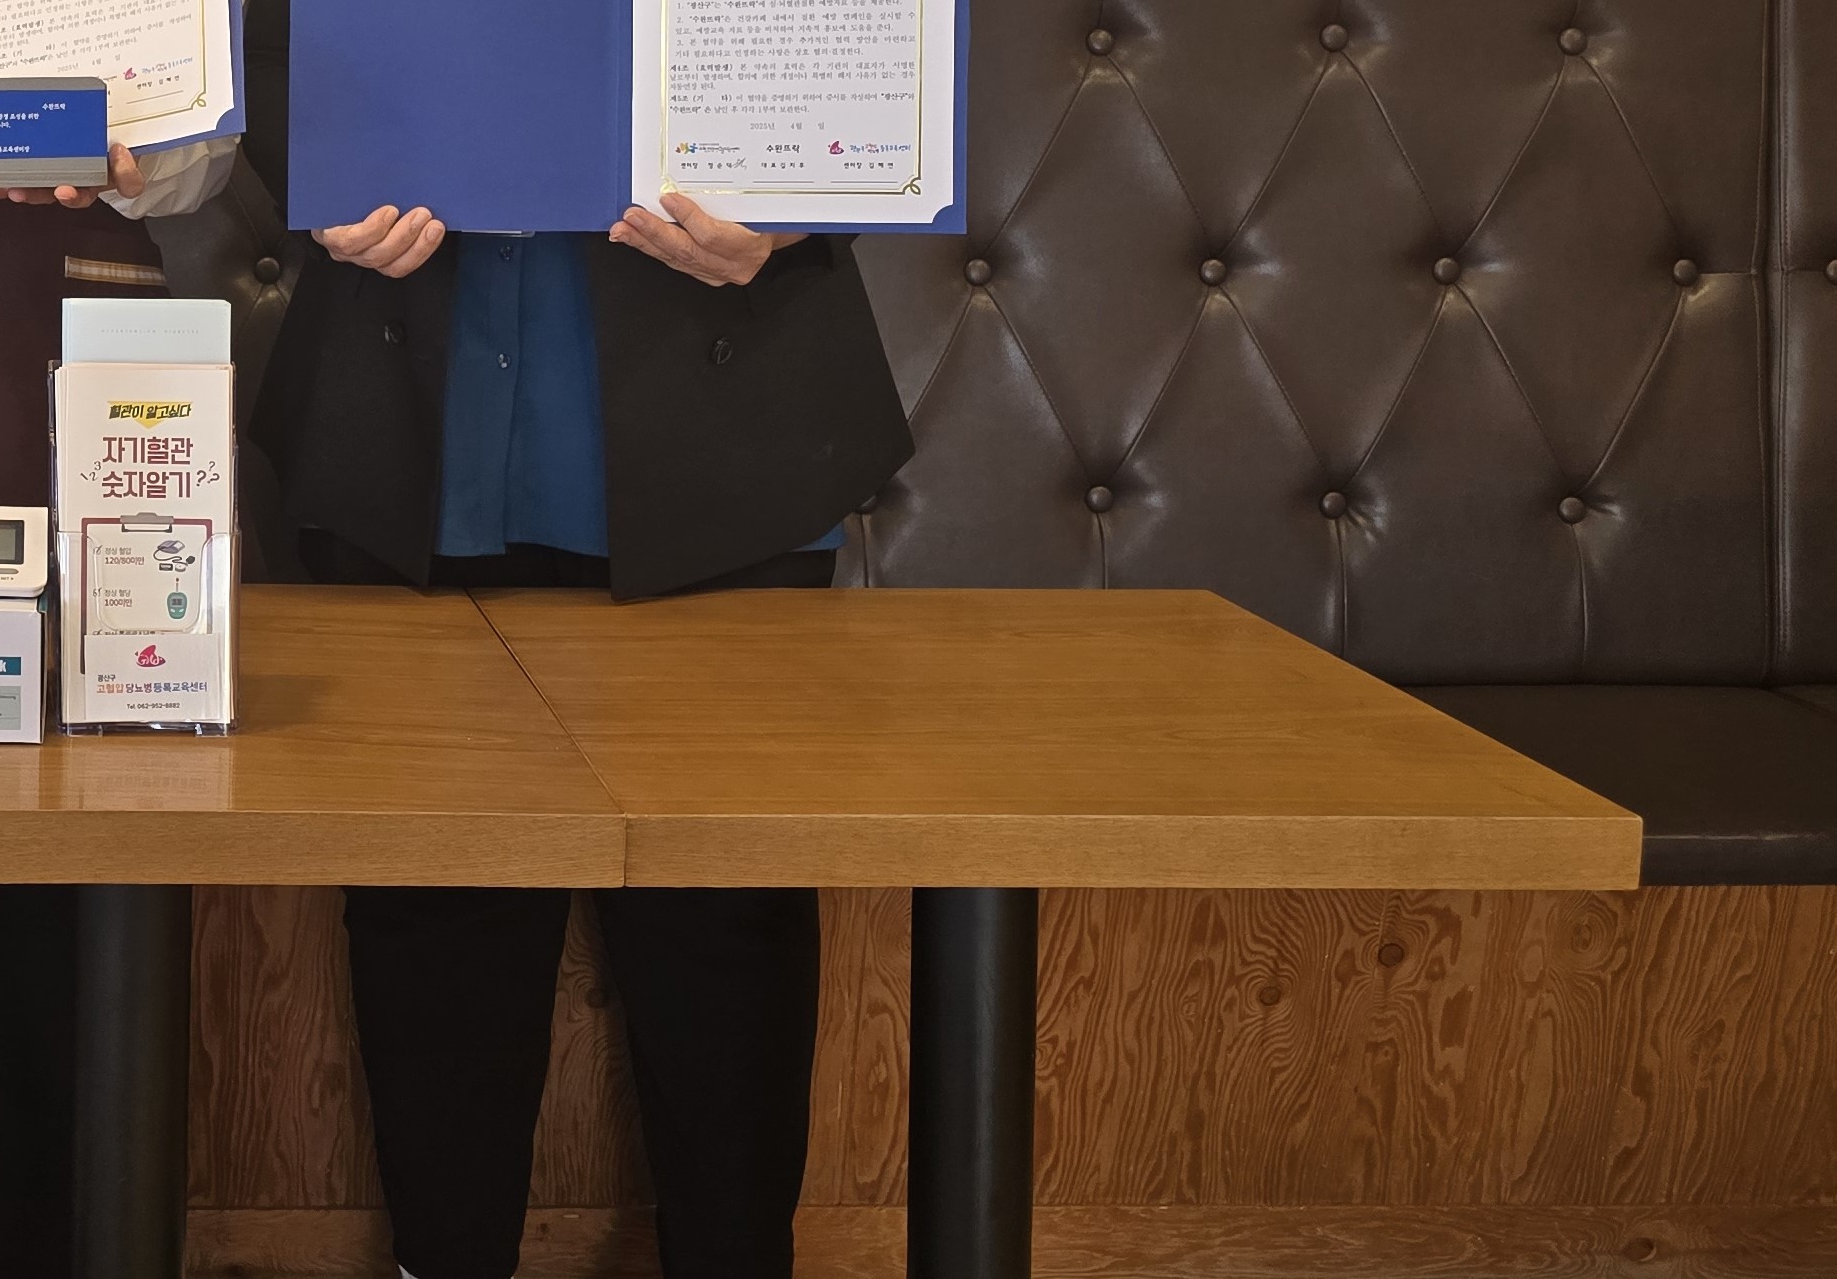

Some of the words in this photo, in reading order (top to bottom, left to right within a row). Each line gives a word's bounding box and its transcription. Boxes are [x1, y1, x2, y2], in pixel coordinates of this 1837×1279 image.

[766, 144, 800, 153] 수완뜨락
[109, 404, 143, 419] 혈관이
[146, 404, 191, 419] 알고싶다
[102, 436, 193, 465] 자기혈관
[101, 471, 190, 498] 숫자알기
